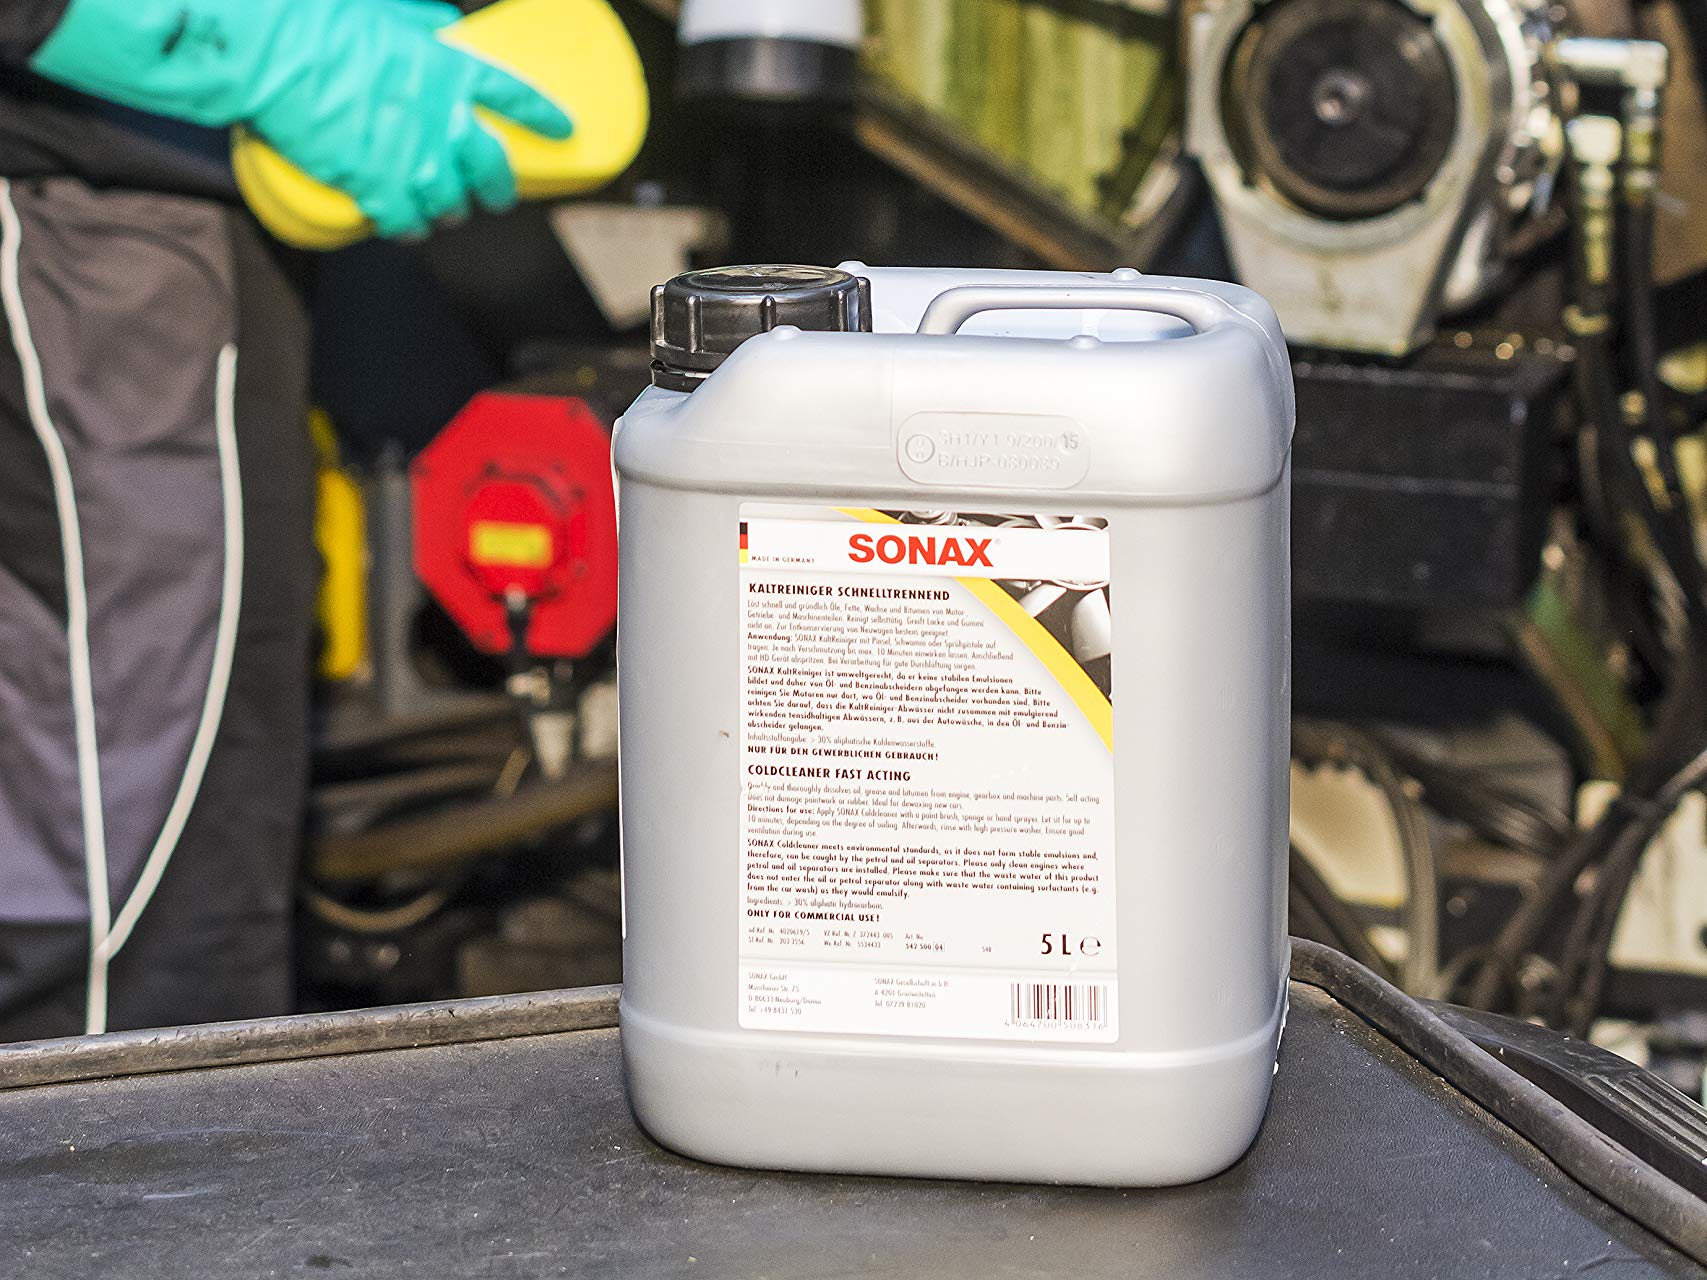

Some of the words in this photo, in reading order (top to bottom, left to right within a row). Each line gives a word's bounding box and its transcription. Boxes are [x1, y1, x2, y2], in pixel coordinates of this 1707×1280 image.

[848, 533, 993, 567] SONAX
[749, 582, 833, 596] KALTREINIGER
[837, 586, 950, 600] SCHNELLTRENNEND
[747, 664, 774, 674] SONAX
[777, 666, 822, 678] KaltReiniger
[824, 668, 834, 677] ist
[896, 670, 906, 680] da
[918, 671, 937, 681] keine
[940, 672, 970, 682] stabilen
[747, 675, 768, 685] bildet
[770, 676, 784, 686] und
[786, 677, 806, 686] daher
[839, 679, 853, 688] und
[855, 680, 923, 691] Benzinabscheidern
[925, 682, 968, 695] abgefangen
[971, 684, 999, 694] werden
[1024, 686, 1041, 695] Bitte
[747, 686, 777, 698] reinigen
[779, 687, 790, 696] Sie
[792, 688, 824, 698] Motoren
[889, 692, 903, 701] und
[905, 693, 968, 704] Benzinabscheider
[971, 695, 1010, 705] vorhanden
[1032, 697, 1050, 706] Bitte
[747, 697, 771, 707] achten
[773, 698, 784, 707] Sie
[816, 700, 833, 709] dass
[835, 701, 846, 710] die
[937, 705, 954, 714] nicht
[957, 708, 996, 716] zusammen
[998, 707, 1010, 716] mit
[1013, 707, 1058, 720] emulgierend
[748, 708, 786, 718] wirkenden
[788, 710, 840, 722] tensidhaltigen
[922, 715, 934, 724] der
[987, 717, 994, 726] in
[996, 718, 1010, 727] den
[1026, 719, 1040, 728] und
[747, 719, 785, 729] abscheider
[747, 745, 766, 754] NUR
[770, 744, 787, 754] FÜR
[790, 747, 808, 755] DEN
[811, 748, 882, 758] GEWERBLICHEN
[884, 751, 938, 760] GEBRAUCH!
[747, 764, 830, 778] COLDCLEANER
[835, 768, 862, 779] FAST
[866, 770, 911, 781] ACTING
[747, 803, 784, 813] Directions
[786, 804, 797, 814] for
[747, 838, 774, 847] SONAX
[776, 839, 818, 849] Coldcleaner
[821, 841, 844, 850] meets
[846, 842, 900, 853] environmental
[955, 846, 961, 855] it
[963, 846, 980, 856] does
[983, 847, 995, 856] not
[998, 848, 1016, 857] form
[1018, 848, 1041, 858] stable
[1043, 849, 1080, 859] emulsions
[801, 851, 810, 860] be
[812, 851, 837, 863] caught
[839, 852, 849, 864] by
[851, 853, 863, 862] the
[865, 854, 888, 865] petrol
[890, 855, 904, 864] and
[906, 855, 916, 864] oil
[963, 857, 987, 867] Please
[990, 858, 1006, 870] only
[1008, 859, 1028, 868] clean
[1030, 860, 1058, 871] engines
[1061, 861, 1084, 870] where
[746, 860, 769, 871] petrol
[771, 861, 785, 870] and
[787, 861, 796, 870] oil
[892, 866, 917, 875] Please
[919, 867, 939, 876] make
[960, 868, 976, 878] that
[979, 869, 990, 878] the
[993, 869, 1016, 879] waste
[1019, 870, 1041, 880] water
[1044, 871, 1052, 880] of
[1054, 872, 1068, 881] this
[1070, 872, 1098, 884] product
[747, 871, 764, 880] does
[766, 872, 779, 881] not
[781, 872, 800, 882] enter
[803, 873, 814, 882] the
[817, 874, 827, 883] oil
[839, 875, 862, 886] petrol
[864, 876, 900, 888] separator
[902, 877, 924, 889] along
[926, 878, 943, 887] with
[946, 879, 968, 888] waste
[971, 880, 993, 889] water
[996, 881, 1035, 893] containing
[1037, 882, 1079, 892] surfactants
[747, 882, 765, 891] from
[767, 883, 778, 892] the
[795, 884, 818, 894] wash)
[831, 885, 848, 897] they
[851, 886, 874, 896] would
[747, 909, 770, 918] ONLY
[773, 910, 791, 919] FOR
[794, 911, 854, 921] COMMERCIAL
[858, 914, 879, 922] USE!
[1040, 933, 1053, 955] 5
[1061, 934, 1072, 956] L
